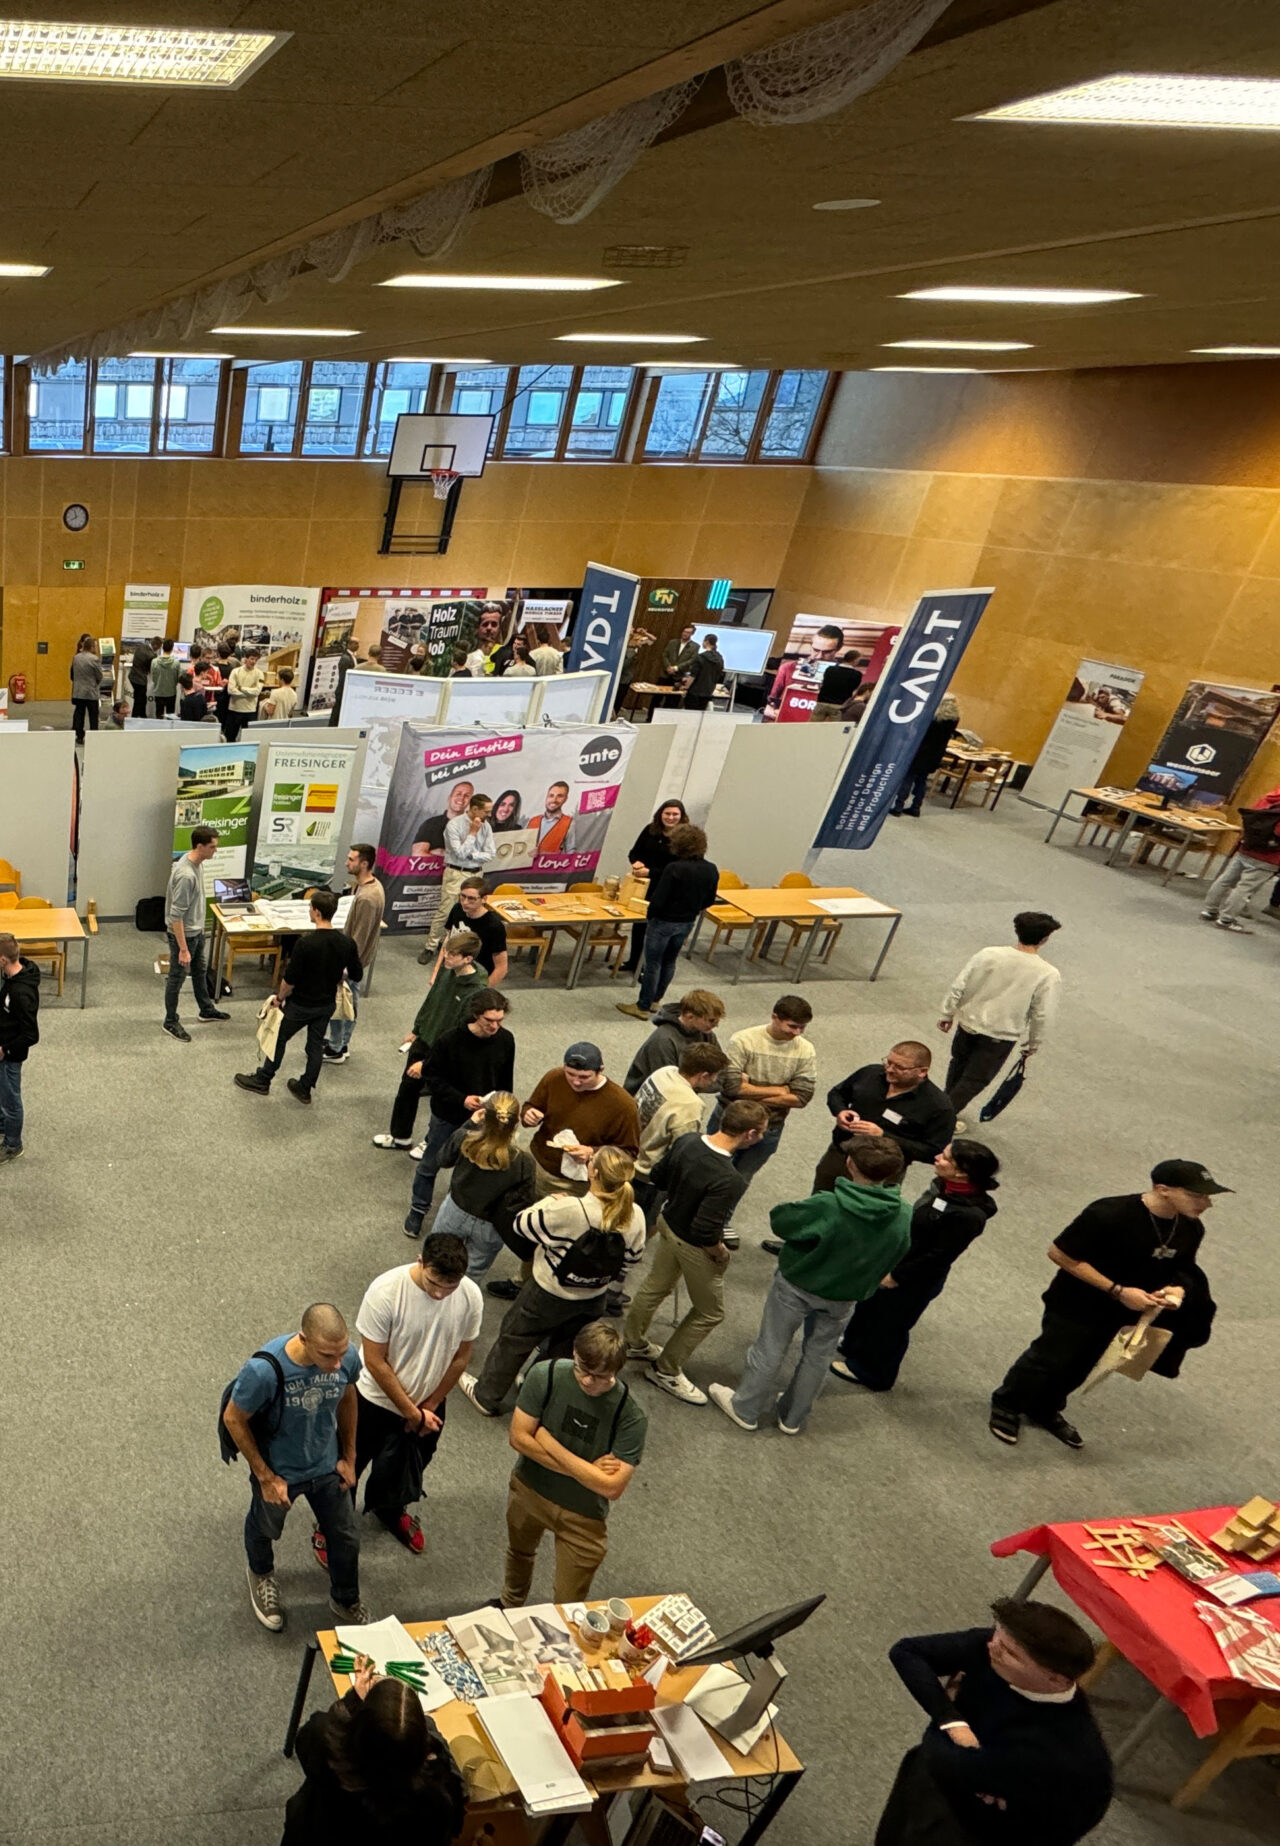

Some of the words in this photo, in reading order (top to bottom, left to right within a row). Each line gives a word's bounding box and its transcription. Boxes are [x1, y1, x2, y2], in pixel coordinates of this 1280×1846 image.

[250, 594, 300, 605] binderholz
[655, 590, 674, 604] FN
[432, 606, 457, 624] Holz
[430, 625, 459, 640] Traum
[430, 751, 461, 762] Dein
[464, 738, 516, 756] Einstieg
[579, 748, 620, 765] ante
[274, 758, 346, 769] FREISINGER
[431, 767, 450, 782] bei
[452, 759, 481, 774] ante
[835, 791, 858, 831] Software
[856, 773, 867, 785] for
[845, 796, 863, 831] Interior
[862, 763, 883, 796] Design
[857, 814, 869, 832] and
[866, 762, 896, 813] Production
[201, 816, 248, 830] freisinger
[409, 857, 440, 871] You
[538, 855, 571, 869] love
[284, 1379, 306, 1393] TOM
[309, 1372, 340, 1384] TAILOR
[285, 1396, 300, 1407] 19
[325, 1387, 340, 1399] 62
